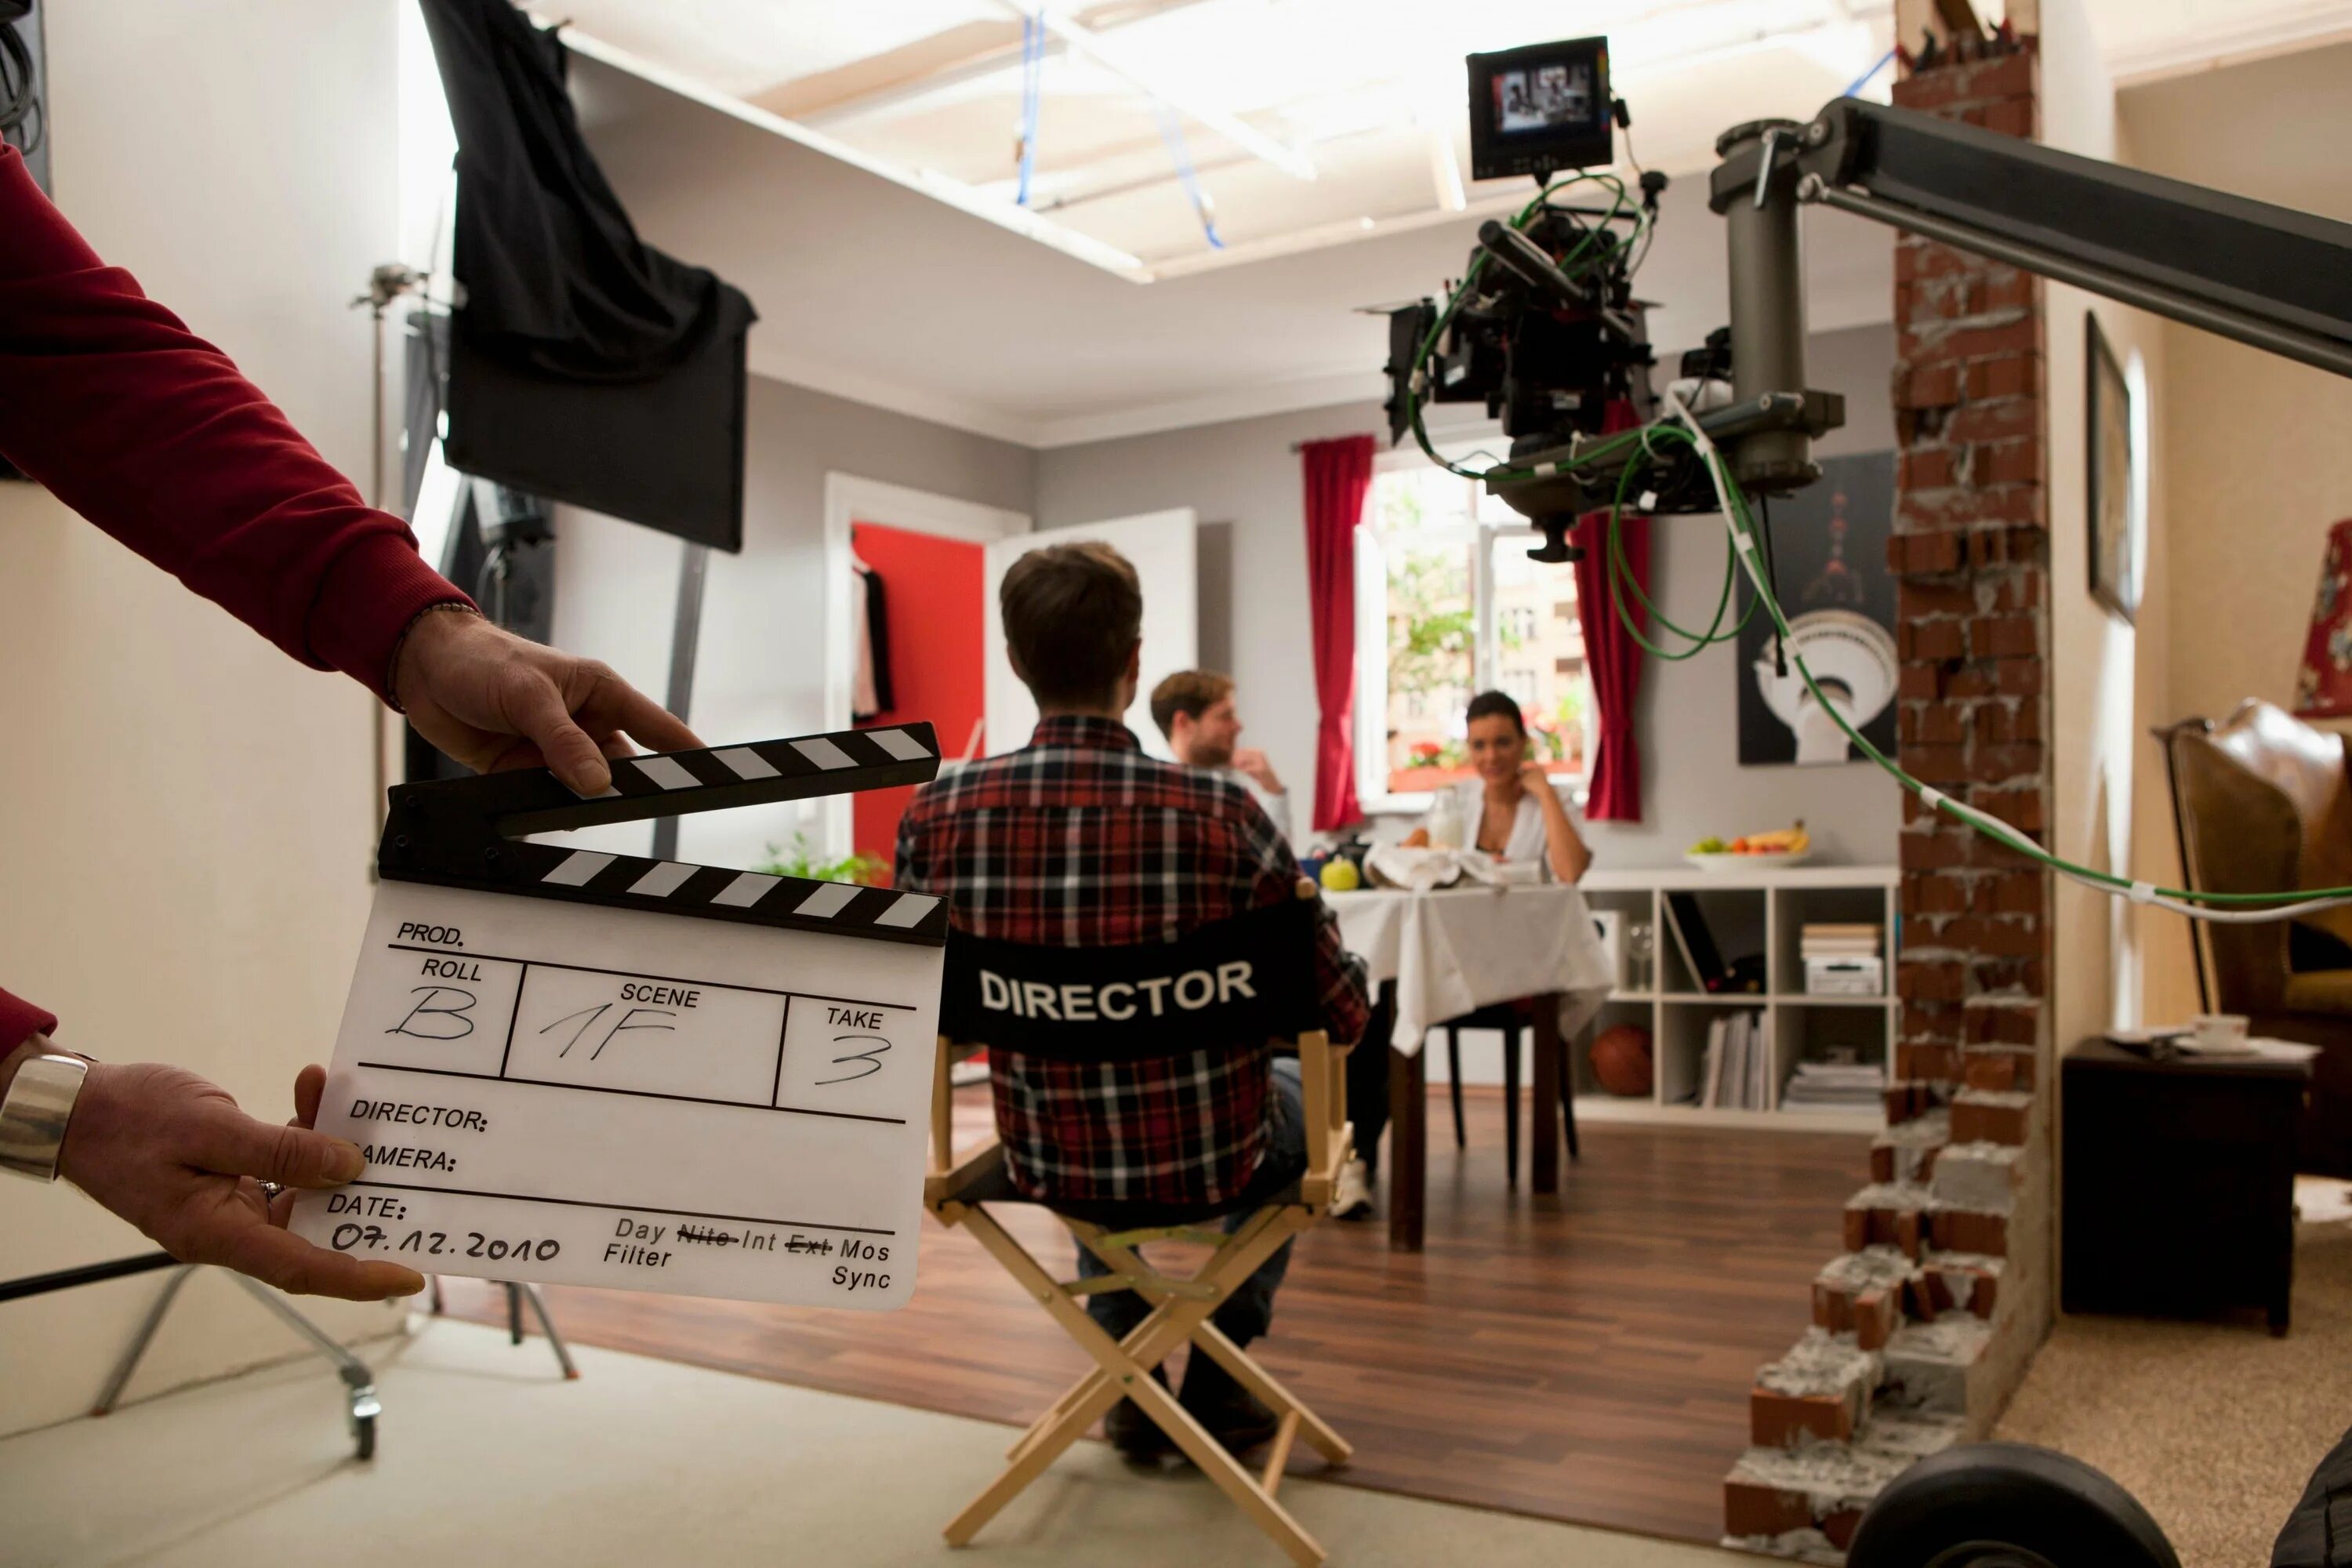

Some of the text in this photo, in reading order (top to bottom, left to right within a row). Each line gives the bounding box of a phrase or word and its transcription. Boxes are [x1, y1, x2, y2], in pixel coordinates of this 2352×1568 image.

[397, 922, 463, 947] PROD.
[421, 958, 482, 982] ROLL
[620, 982, 701, 1008] SCENE
[979, 960, 1257, 1021] DIRECTOR
[385, 985, 477, 1040] B
[827, 1007, 884, 1030] TAKE
[815, 1035, 892, 1085] 3
[350, 1099, 488, 1132] DIRECTOR:
[354, 1142, 456, 1172] AMERA:
[327, 1193, 407, 1221] DATE:
[331, 1223, 561, 1261] 07.12.2010
[615, 1218, 666, 1245] Day
[742, 1230, 777, 1251] Int
[840, 1239, 890, 1261] Mos
[603, 1243, 672, 1268] Filter
[833, 1266, 891, 1290] Sync
